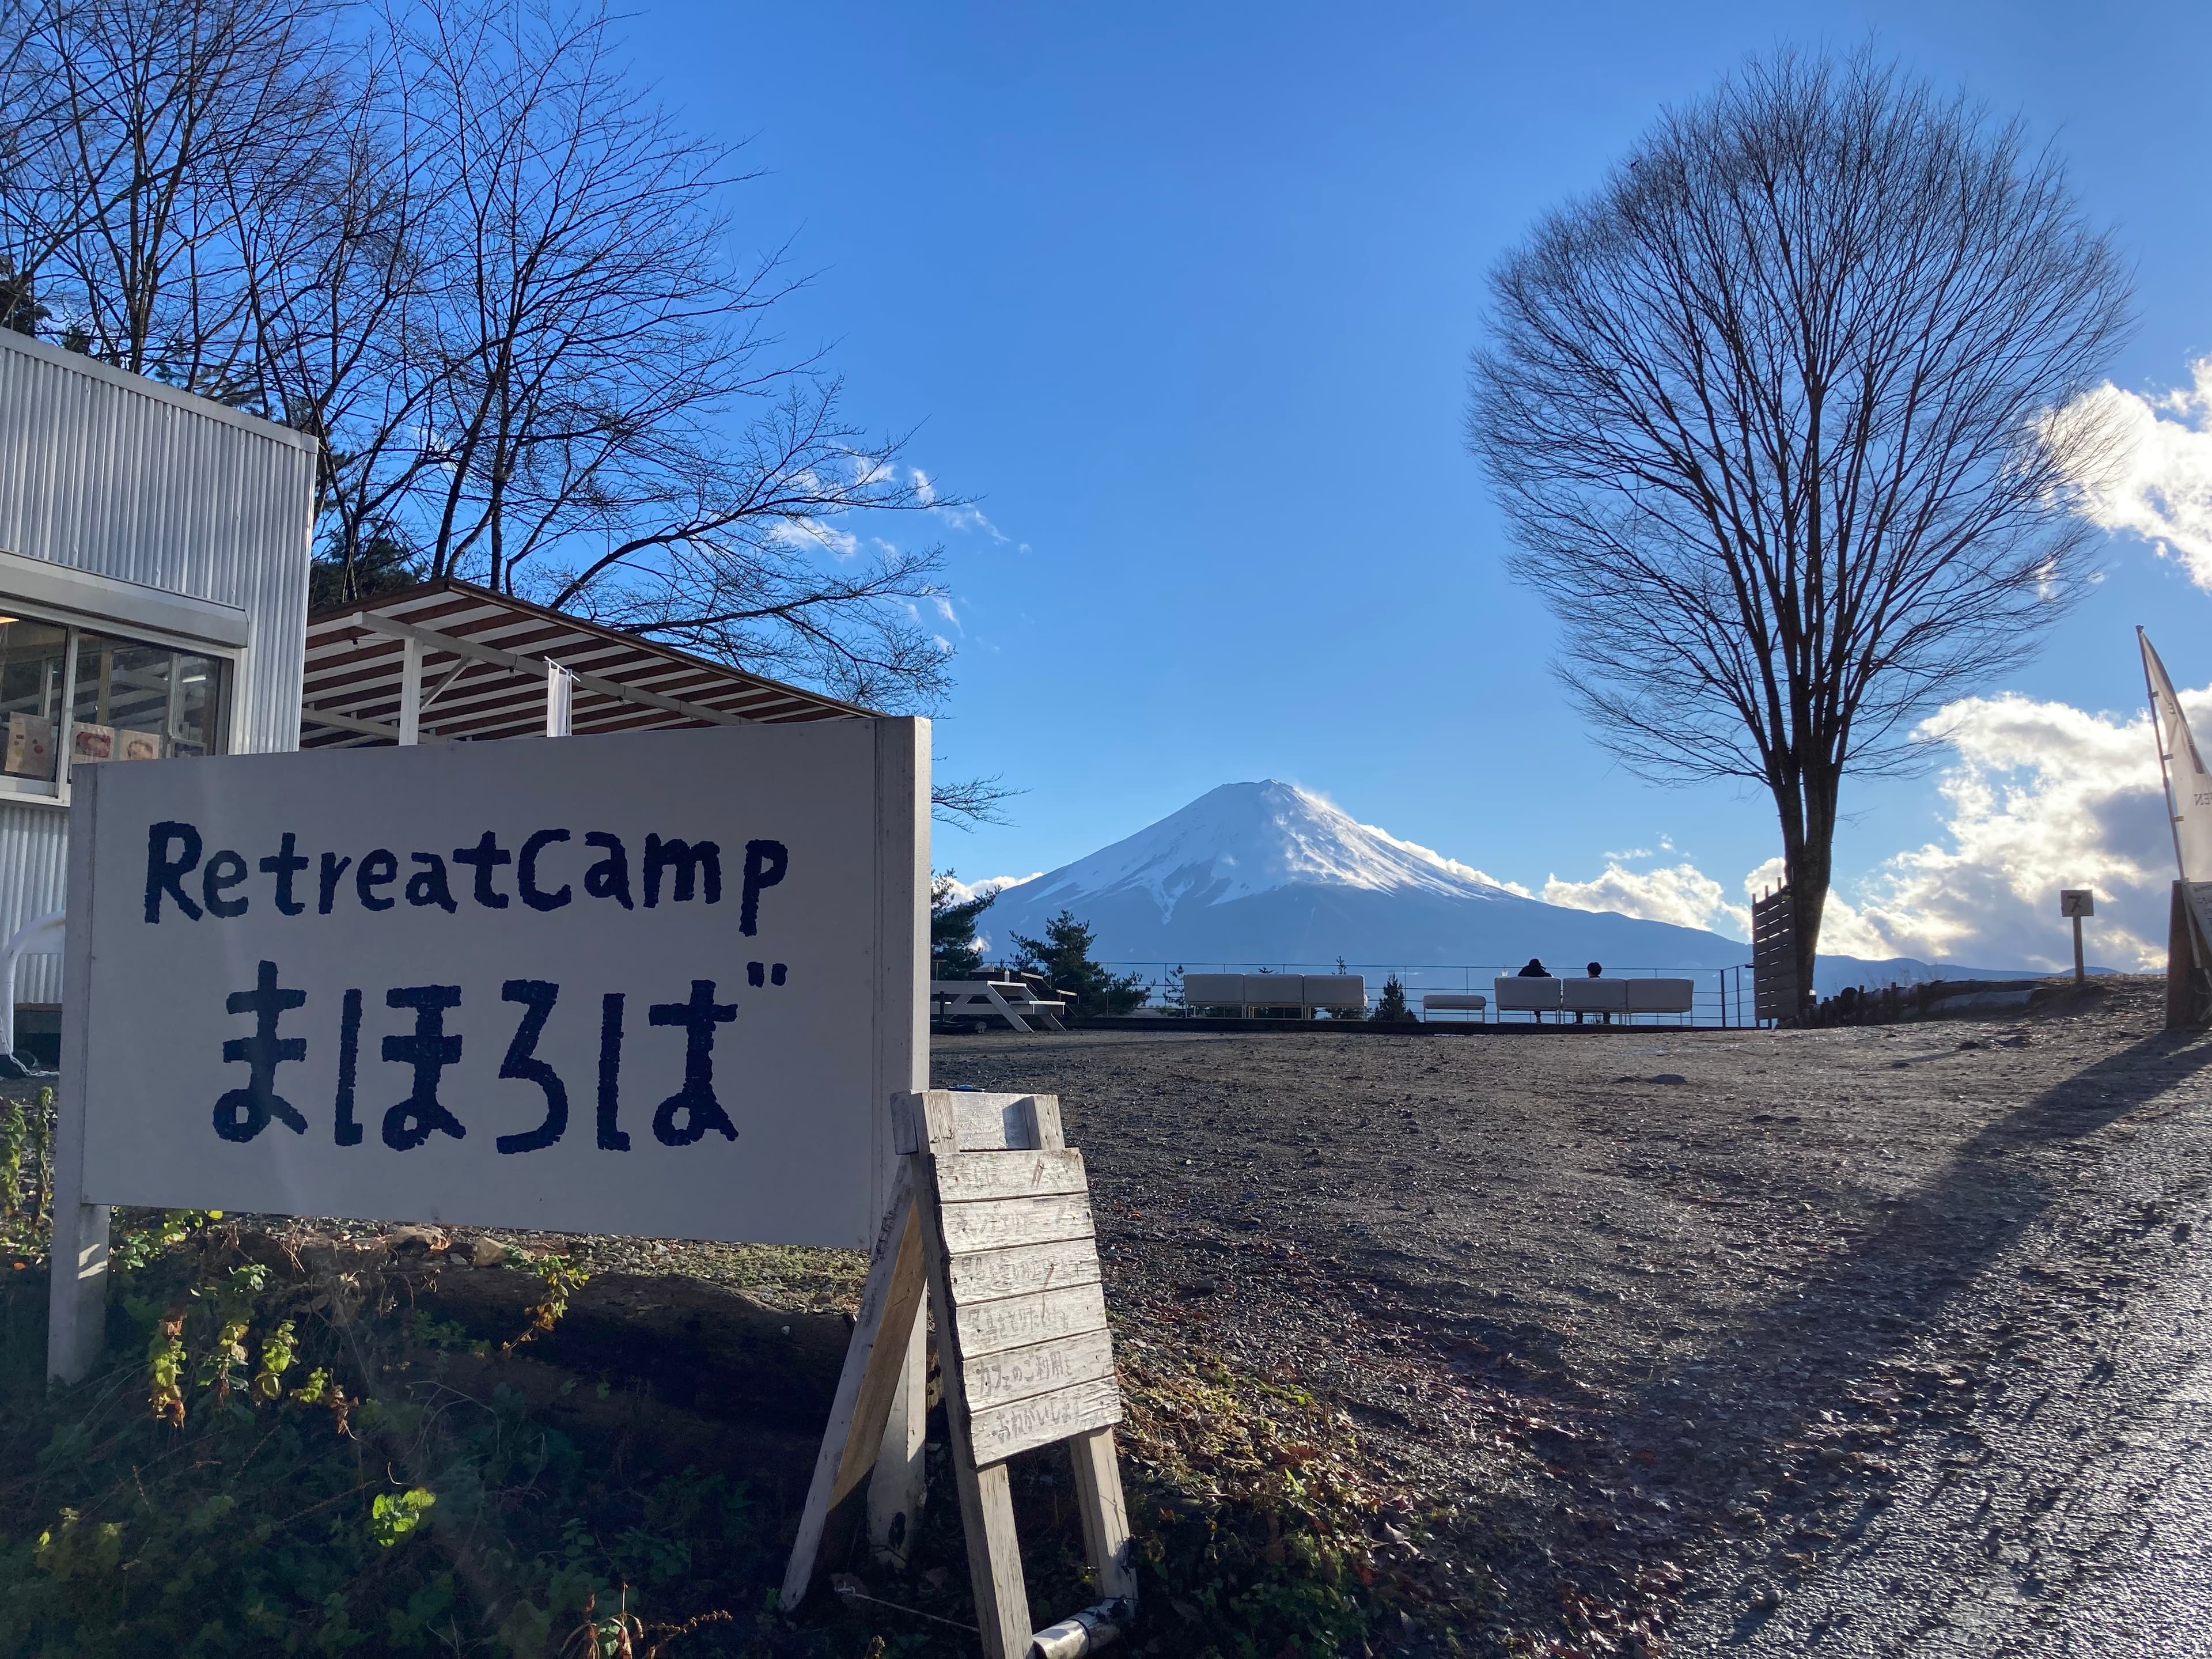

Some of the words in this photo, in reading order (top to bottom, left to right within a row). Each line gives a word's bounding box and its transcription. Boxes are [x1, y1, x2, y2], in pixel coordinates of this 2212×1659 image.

[144, 821, 789, 938] RetreatCamp
[213, 960, 788, 1155] まほろば
